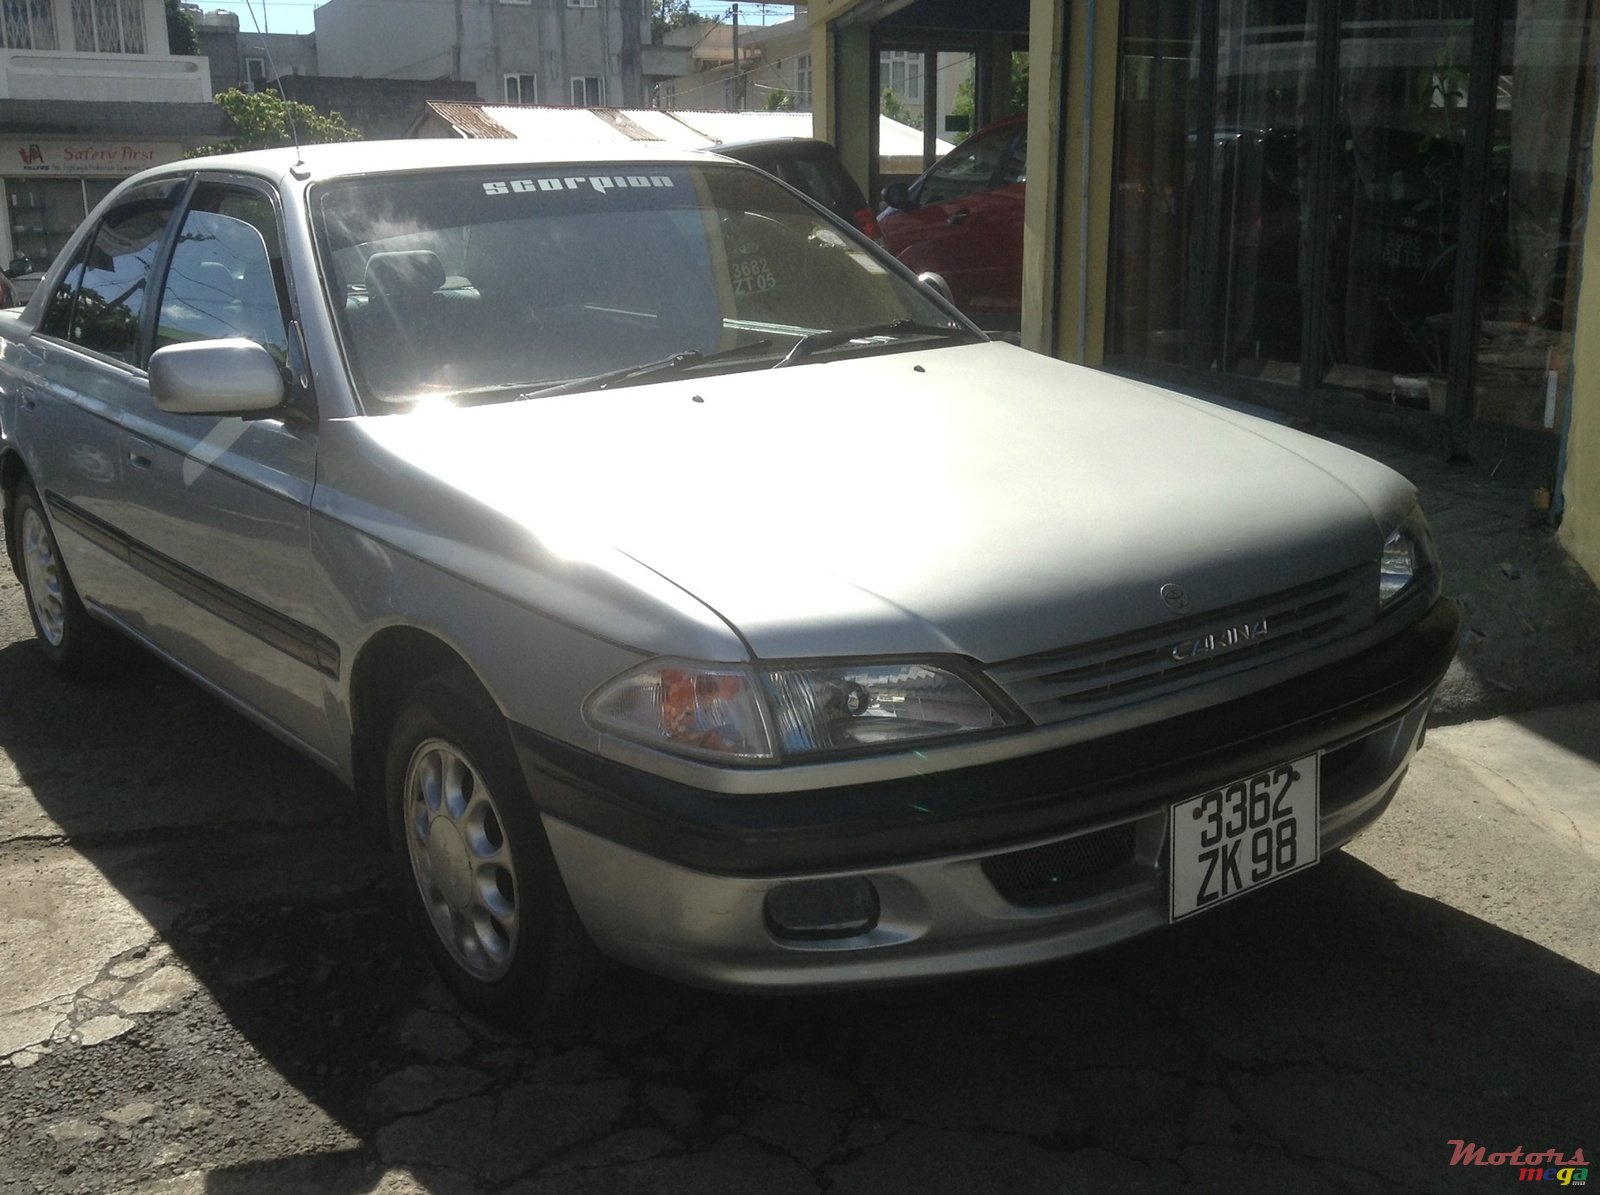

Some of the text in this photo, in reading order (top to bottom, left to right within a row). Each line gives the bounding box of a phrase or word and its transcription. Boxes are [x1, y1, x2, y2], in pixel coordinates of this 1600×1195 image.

[63, 145, 117, 164] Safety
[482, 176, 675, 195] scorpion
[732, 258, 769, 278] 3682
[757, 272, 776, 289] 05
[1172, 618, 1268, 660] CARINA
[1201, 764, 1293, 848] 3362
[1197, 817, 1297, 907] ZK 98
